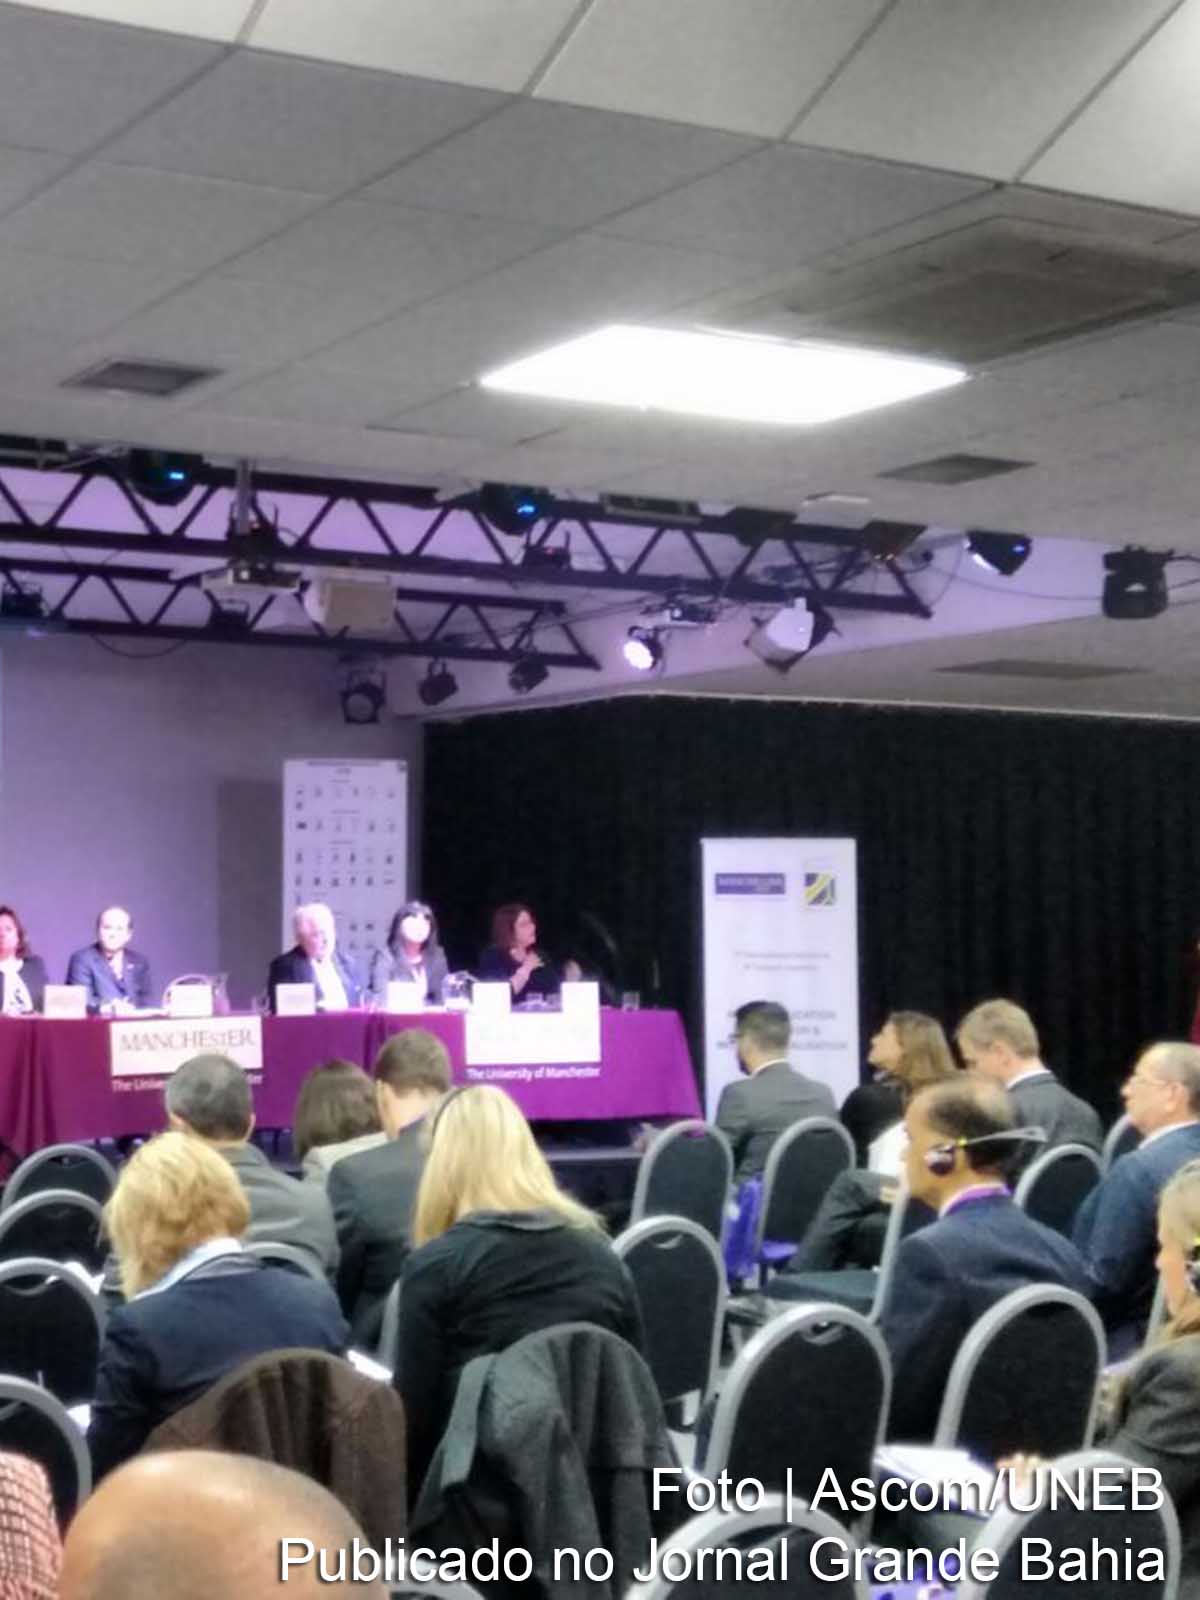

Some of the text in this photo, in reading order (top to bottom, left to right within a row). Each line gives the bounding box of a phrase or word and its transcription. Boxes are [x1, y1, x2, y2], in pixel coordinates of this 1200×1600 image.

[120, 1029, 256, 1051] MANCHESTER
[466, 1066, 600, 1082] The University of Manchester
[112, 1079, 132, 1091] The
